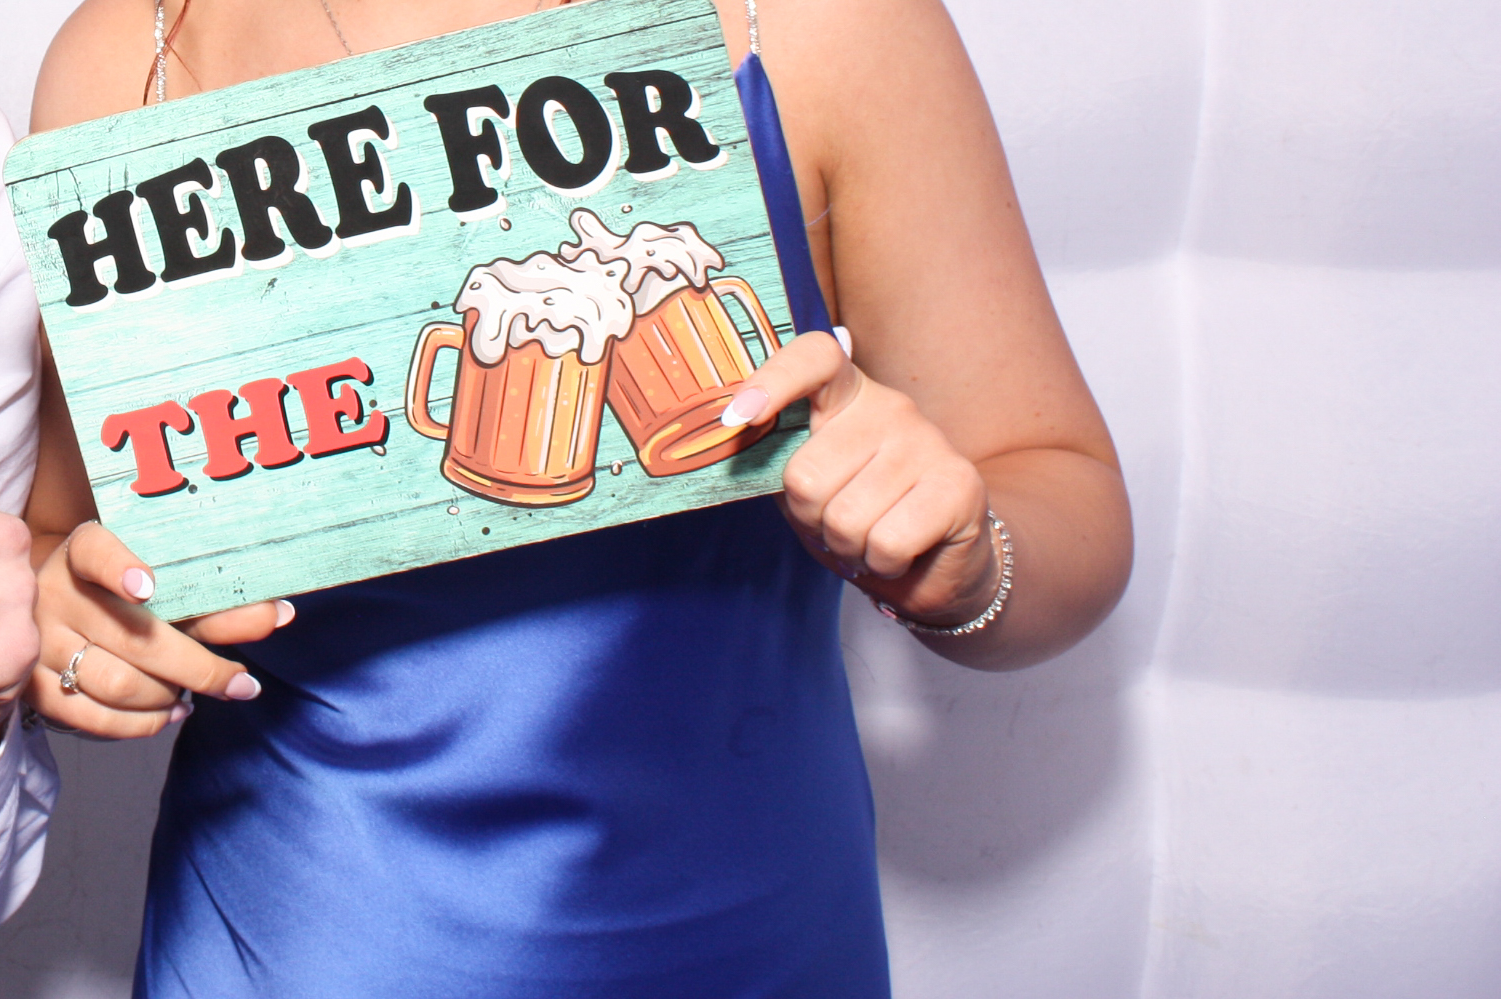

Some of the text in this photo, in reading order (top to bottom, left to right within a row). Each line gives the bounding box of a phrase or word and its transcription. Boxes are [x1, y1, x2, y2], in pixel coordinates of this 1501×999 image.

[47, 68, 725, 310] HERE FOR
[100, 355, 388, 498] THE
